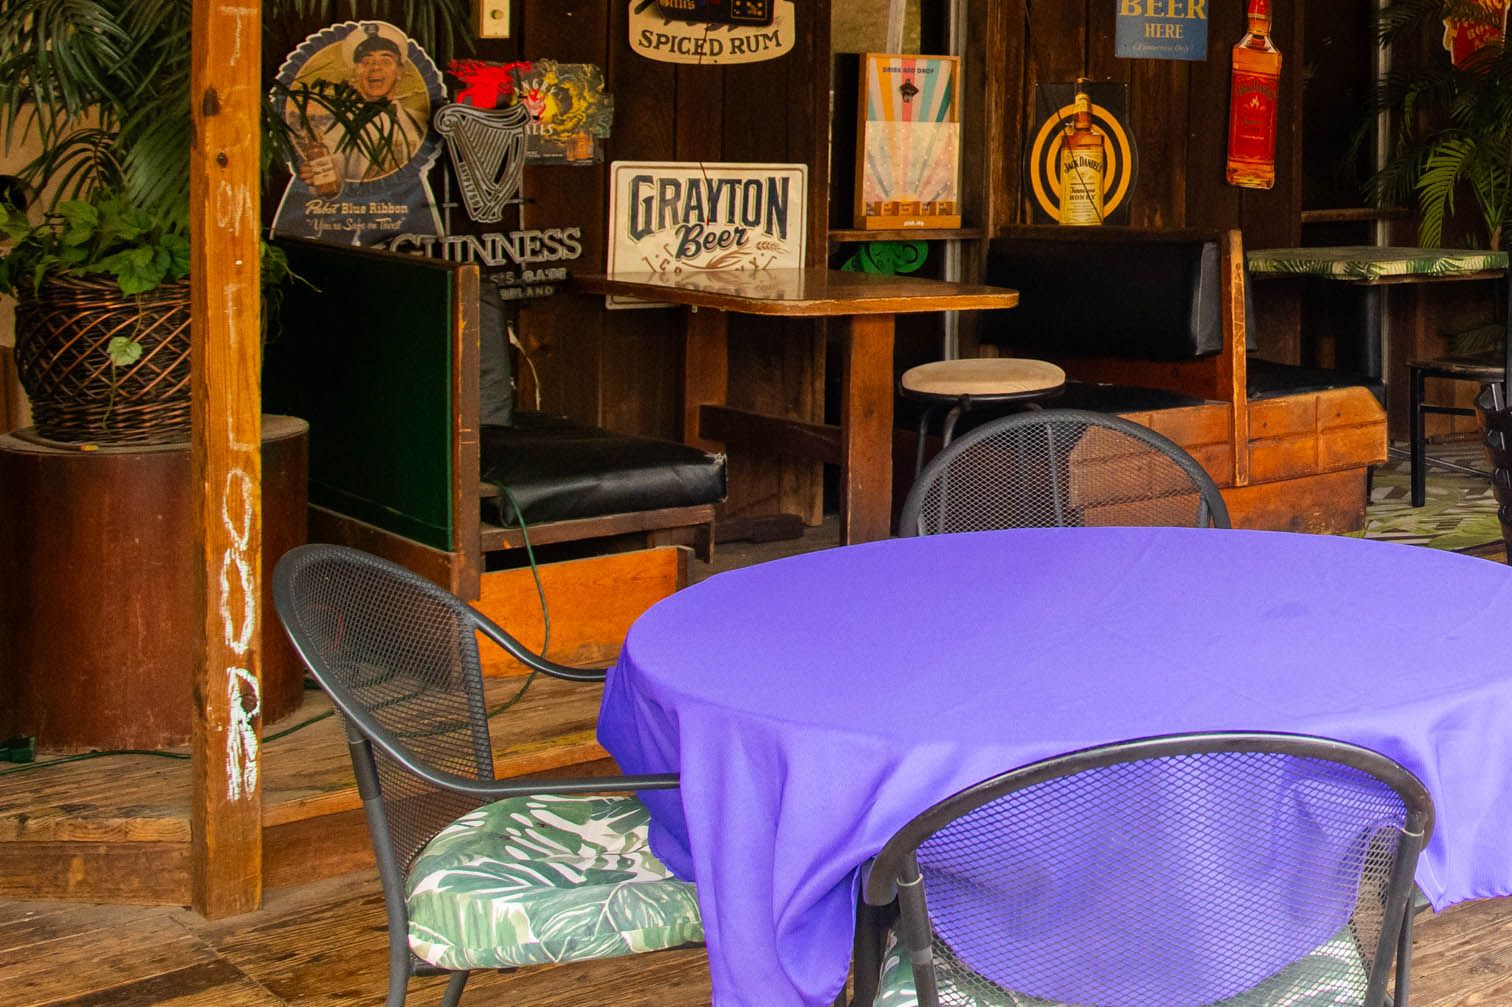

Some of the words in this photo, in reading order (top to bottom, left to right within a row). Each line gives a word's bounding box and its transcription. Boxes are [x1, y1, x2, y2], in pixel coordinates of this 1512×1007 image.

[637, 29, 724, 57] SPICED
[729, 29, 783, 56] RUM
[1145, 23, 1184, 40] HERE
[1063, 158, 1079, 174] JACK
[305, 199, 340, 215] Pabst
[341, 202, 366, 214] Blue
[369, 201, 408, 214] Ribbon
[628, 174, 790, 240] GRAYTON
[389, 227, 583, 267] GUINNESS
[675, 223, 749, 261] Beer
